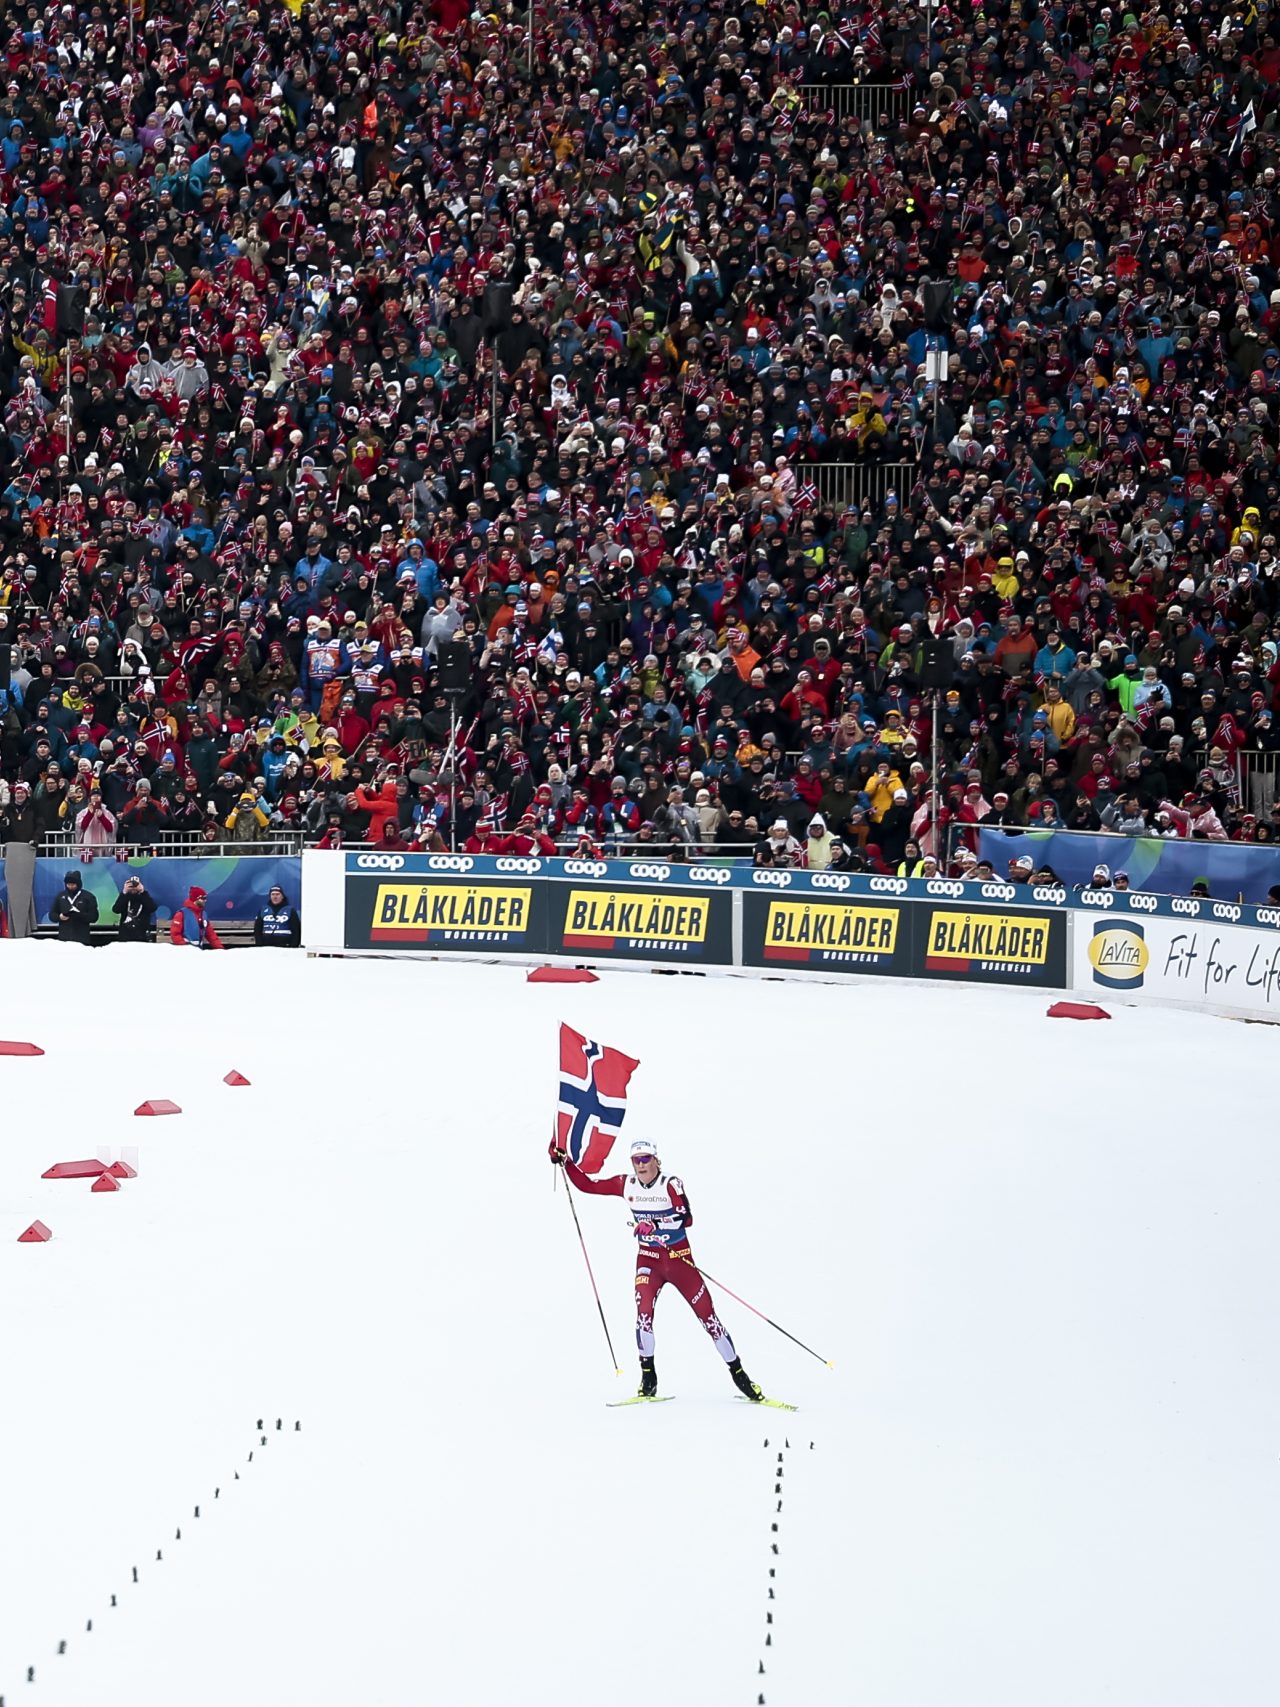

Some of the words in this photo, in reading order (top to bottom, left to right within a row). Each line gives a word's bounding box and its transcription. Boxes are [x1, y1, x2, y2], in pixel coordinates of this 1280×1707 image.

[357, 855, 405, 870] coop
[428, 856, 474, 872] coop
[495, 857, 542, 874] coop
[563, 860, 607, 877] coop
[629, 864, 671, 881] coop
[688, 867, 731, 885] coop
[752, 870, 792, 888] coop
[810, 873, 851, 891] coop
[869, 876, 908, 895] coop
[926, 880, 964, 899] coop
[981, 883, 1015, 901] coop
[1032, 887, 1066, 905] coop
[1081, 890, 1114, 909] coop
[1129, 893, 1158, 912] coop
[1171, 898, 1200, 916] coop
[1213, 902, 1241, 922] coop
[380, 887, 523, 927] BLÅKLÄDER
[444, 930, 509, 941] WORKWEAR
[571, 894, 702, 937] BLÅKLÄDER
[771, 905, 893, 948] BLÅKLÄDER
[628, 939, 688, 951] WORKWEAR
[822, 950, 879, 963] WORKWEAR
[933, 915, 1045, 960] BLÅKLÄDER
[981, 960, 1032, 974] WORKWEAR
[1163, 933, 1198, 979] Fit
[1204, 937, 1238, 994] for
[691, 1284, 706, 1305] CRAFT
